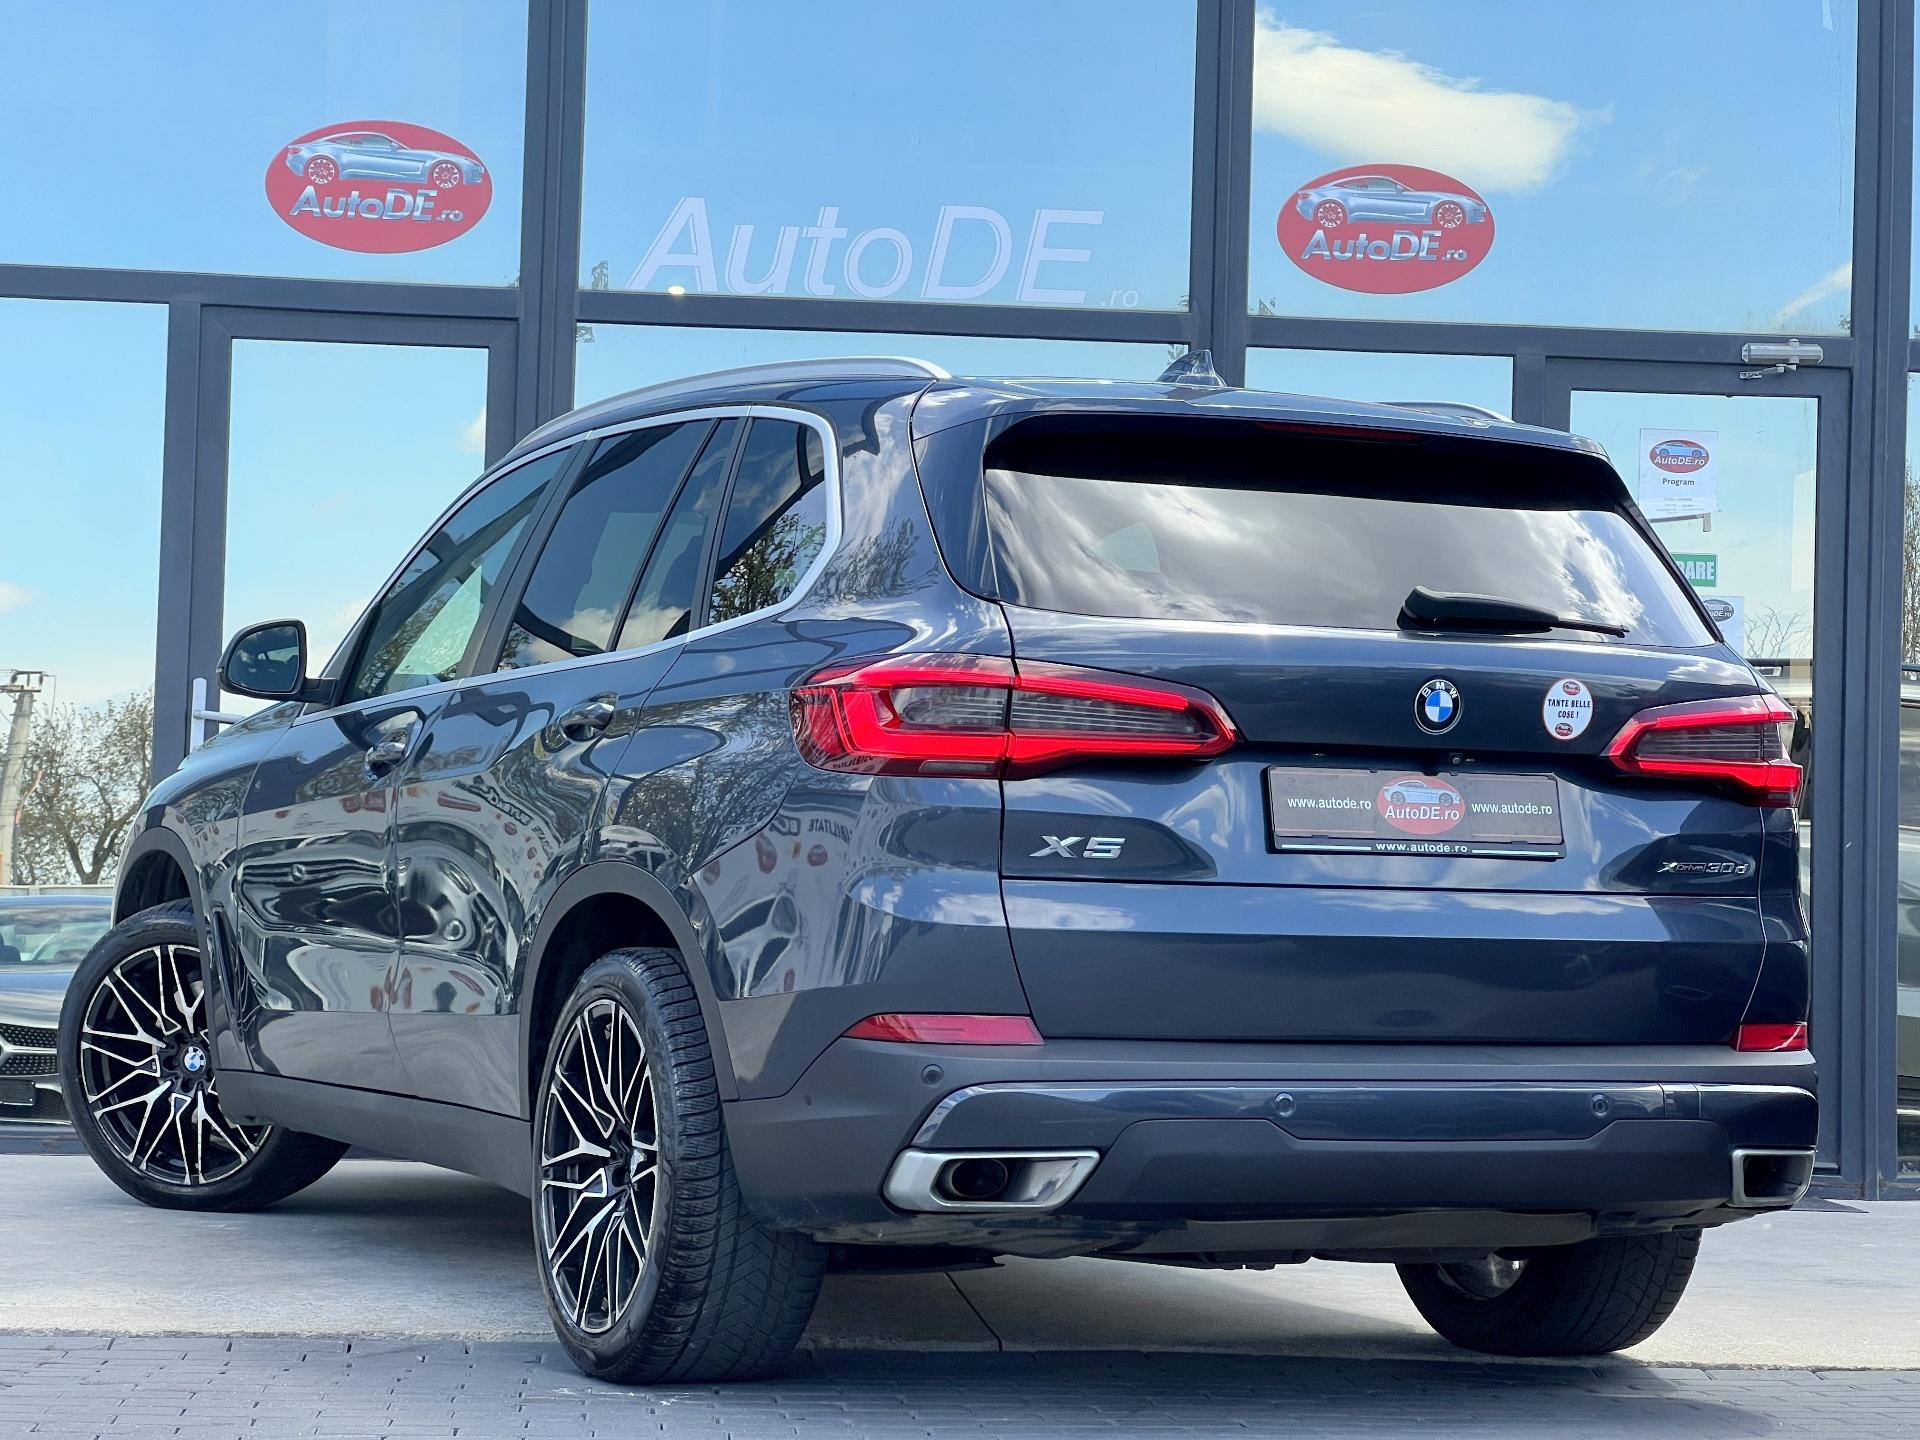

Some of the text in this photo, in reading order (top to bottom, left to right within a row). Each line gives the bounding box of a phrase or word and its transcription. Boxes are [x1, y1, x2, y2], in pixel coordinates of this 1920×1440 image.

[1654, 456, 1705, 466] AutoDE.ro
[1662, 477, 1695, 487] Program
[1421, 681, 1458, 699] BMW
[1548, 699, 1591, 708] TANTE BELLE
[1557, 710, 1575, 719] COSE
[1287, 797, 1372, 810] www.autode.ro
[1471, 803, 1553, 815] www.autode.ro
[1384, 805, 1460, 820] AutoDE.ro
[1028, 835, 1126, 858] X5
[1375, 843, 1468, 853] www.autode.ro
